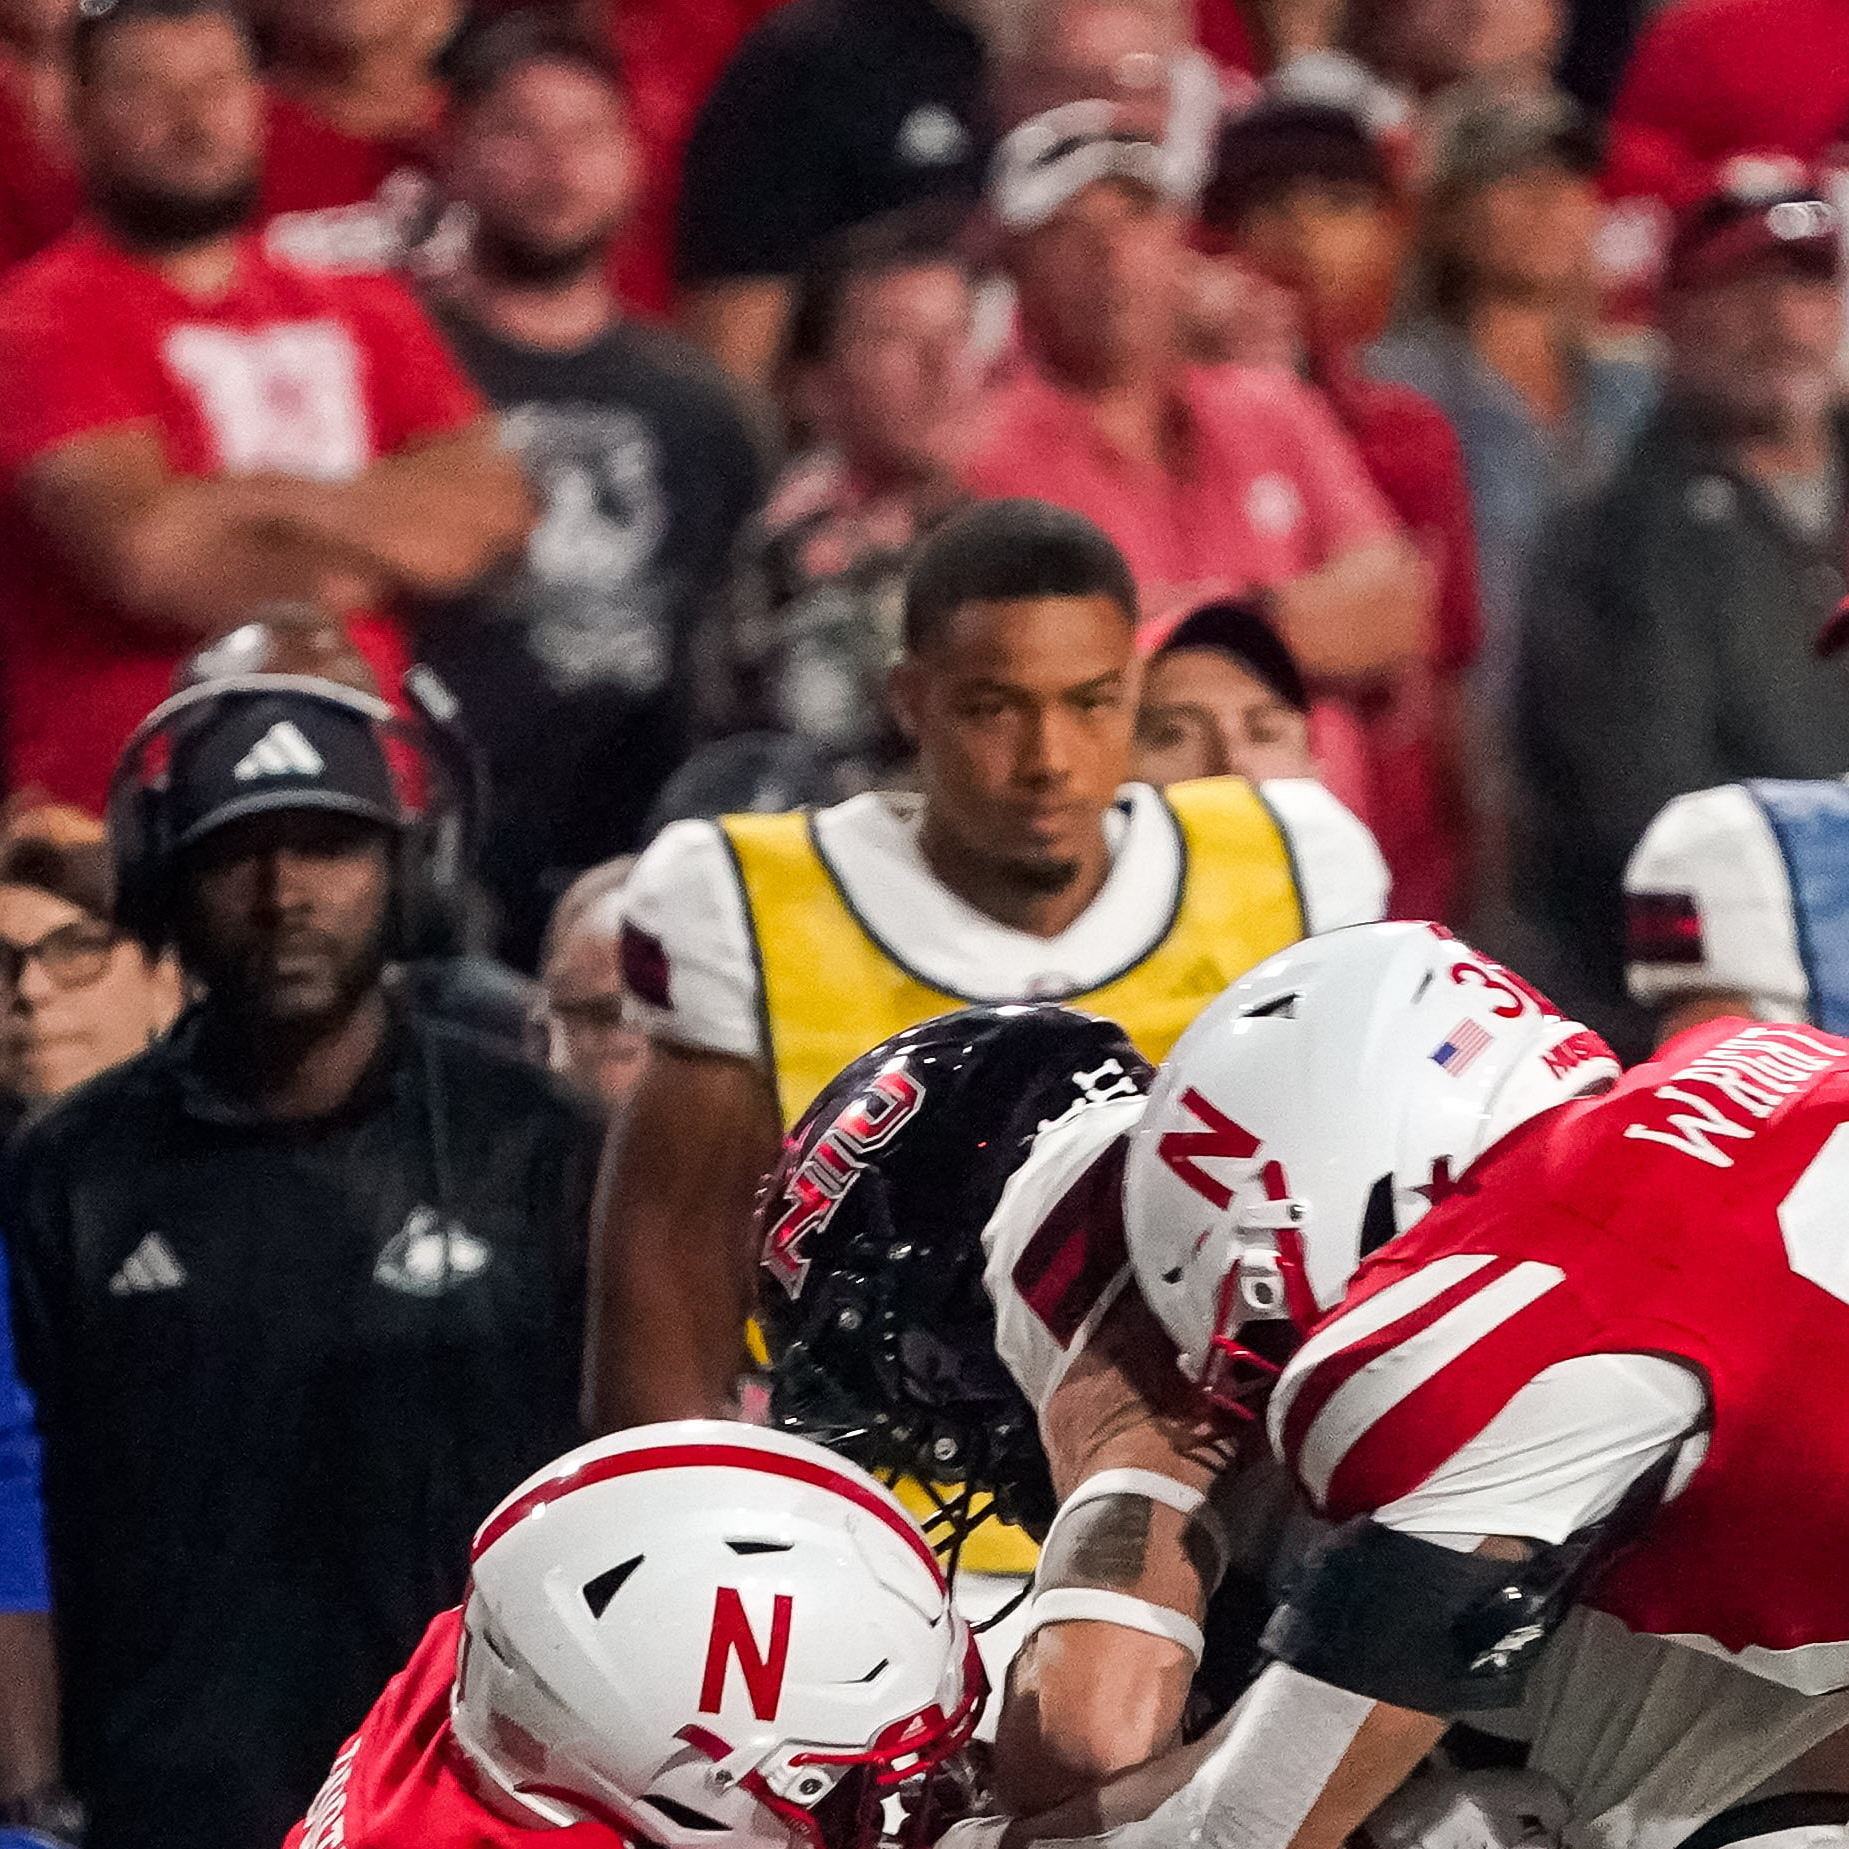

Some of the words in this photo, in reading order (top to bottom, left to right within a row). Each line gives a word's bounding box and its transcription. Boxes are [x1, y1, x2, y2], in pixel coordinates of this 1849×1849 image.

[1157, 1085, 1264, 1212] N
[1624, 1027, 1848, 1168] WRIGHT
[698, 1586, 793, 1723] N
